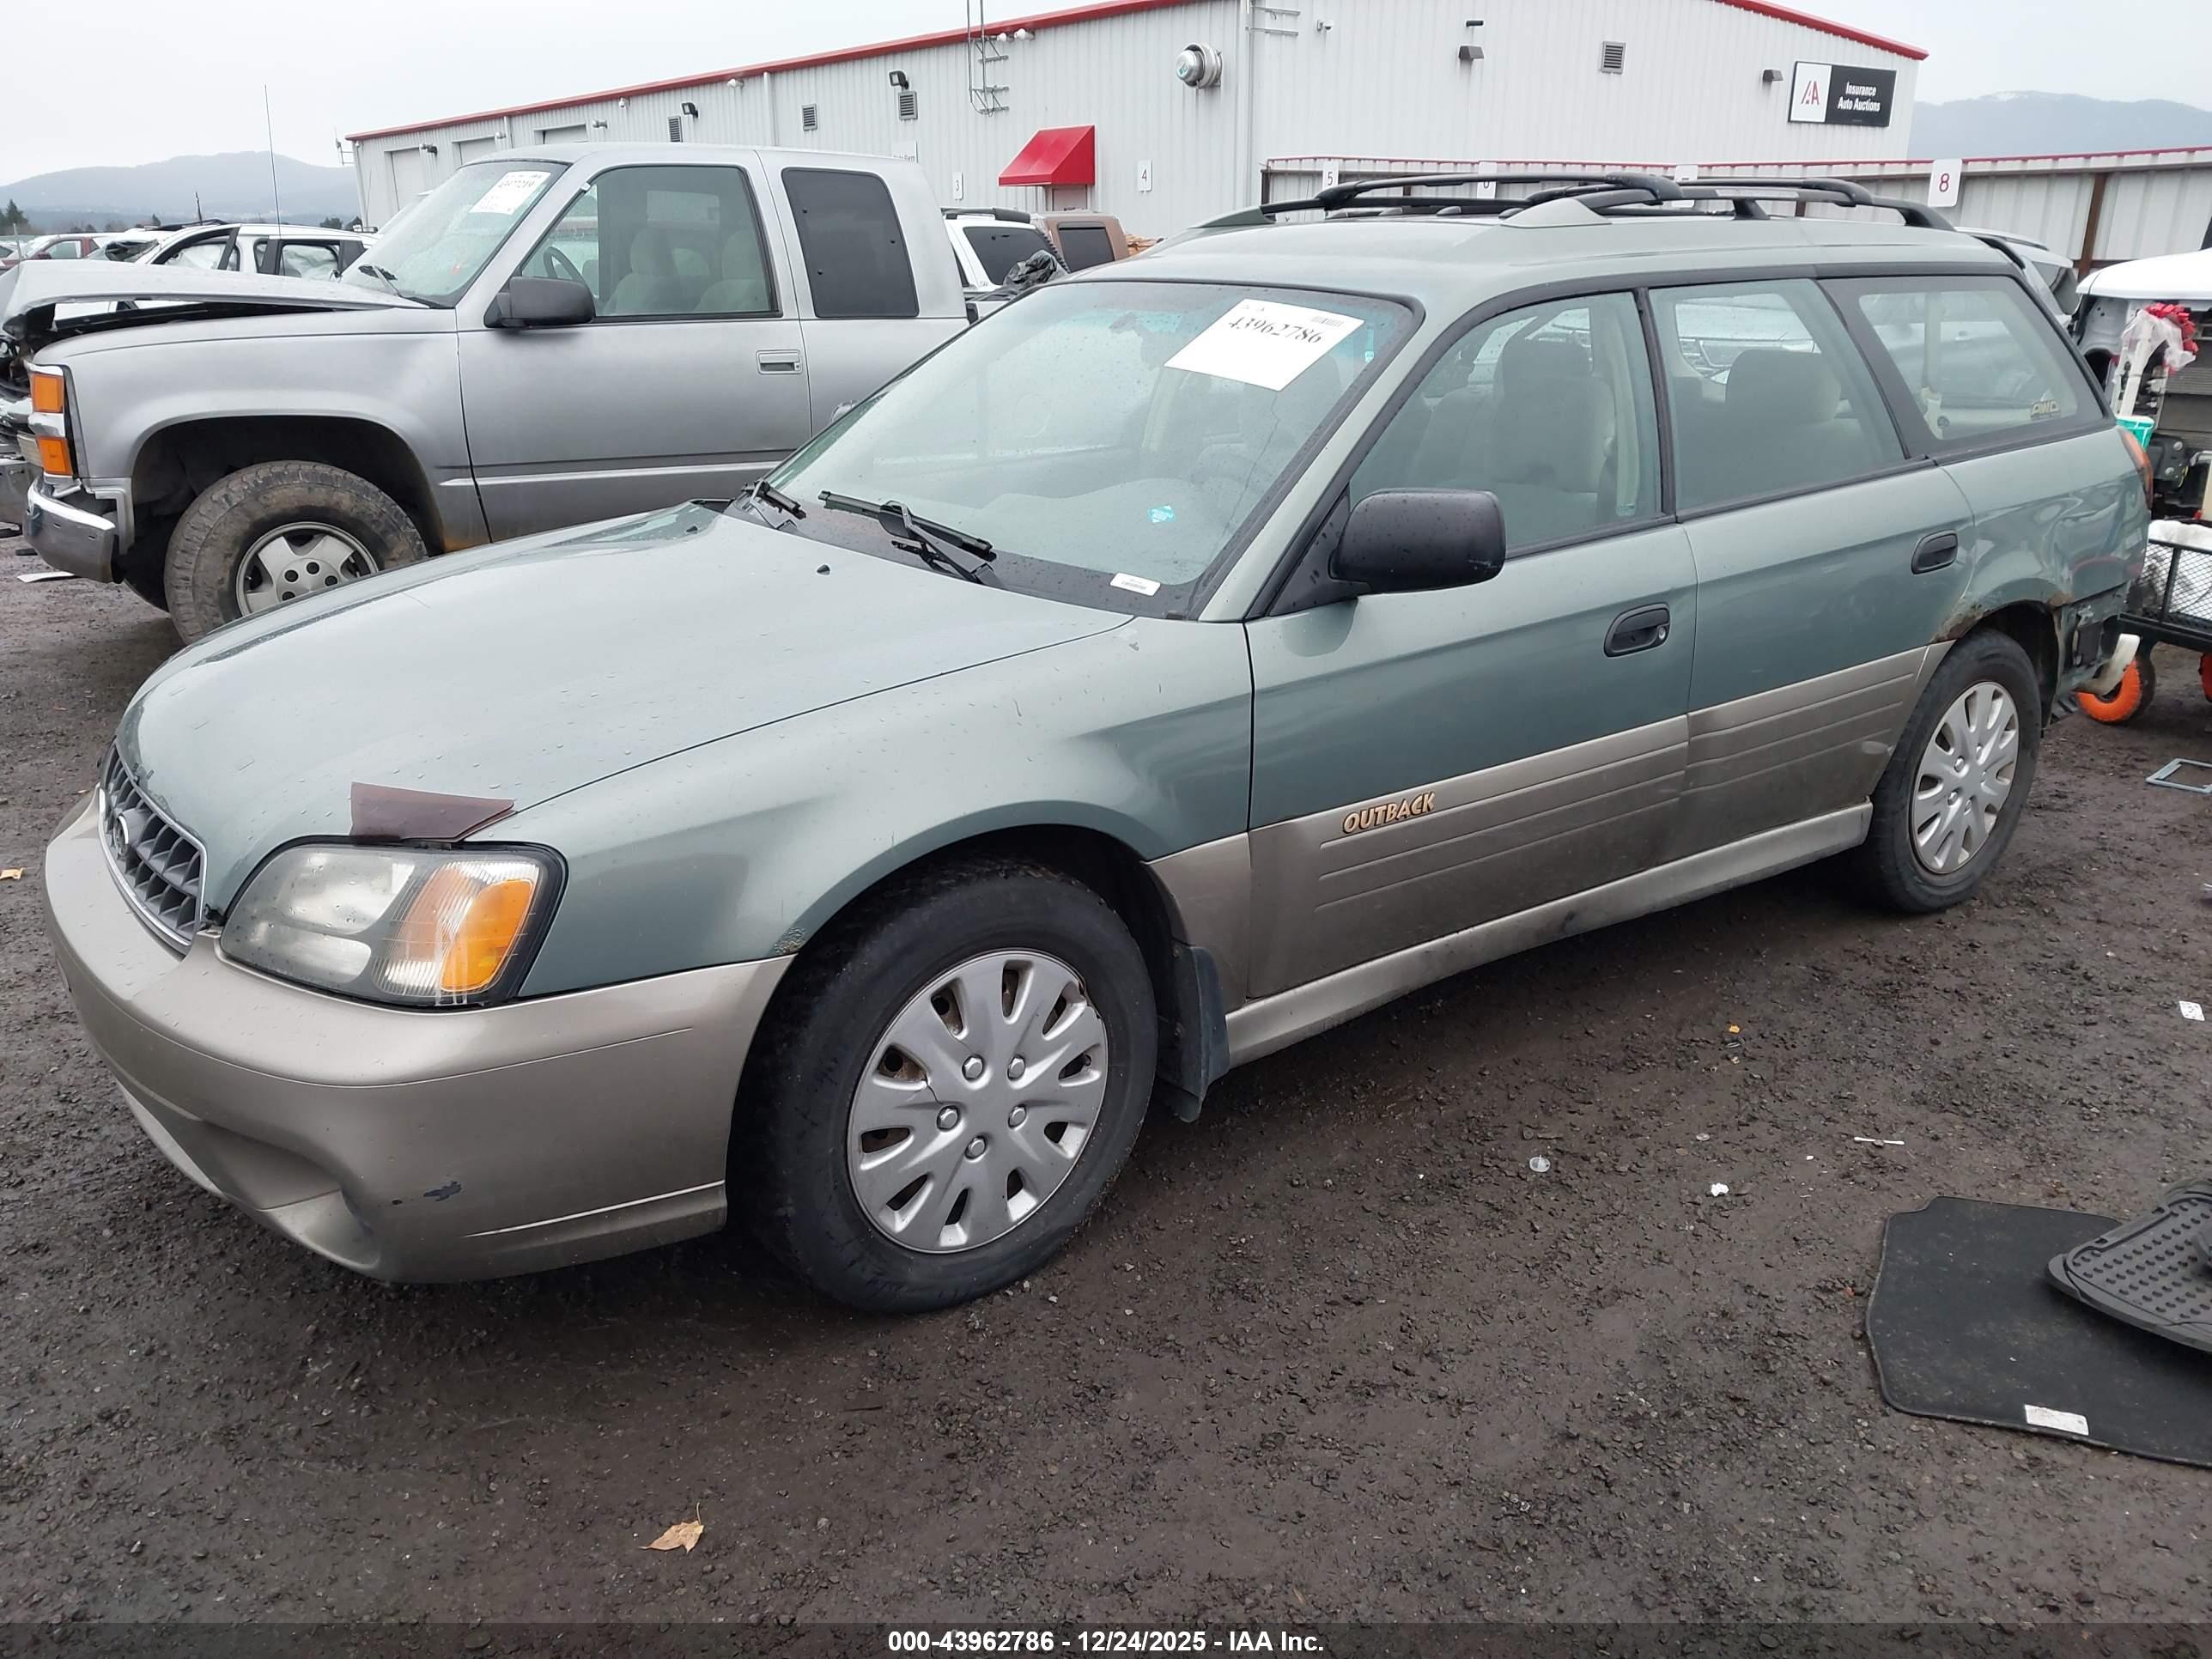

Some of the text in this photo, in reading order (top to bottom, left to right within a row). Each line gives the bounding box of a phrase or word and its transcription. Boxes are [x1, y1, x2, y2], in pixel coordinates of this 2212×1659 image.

[1845, 82, 1877, 97] Insurance
[1838, 96, 1881, 112] Auto Auctions
[1141, 168, 1147, 183] 4
[1328, 172, 1334, 186] 5
[1939, 173, 1950, 192] 8
[955, 179, 960, 192] 3
[1228, 315, 1322, 343] 43962786
[1343, 792, 1435, 834] OUTBACK
